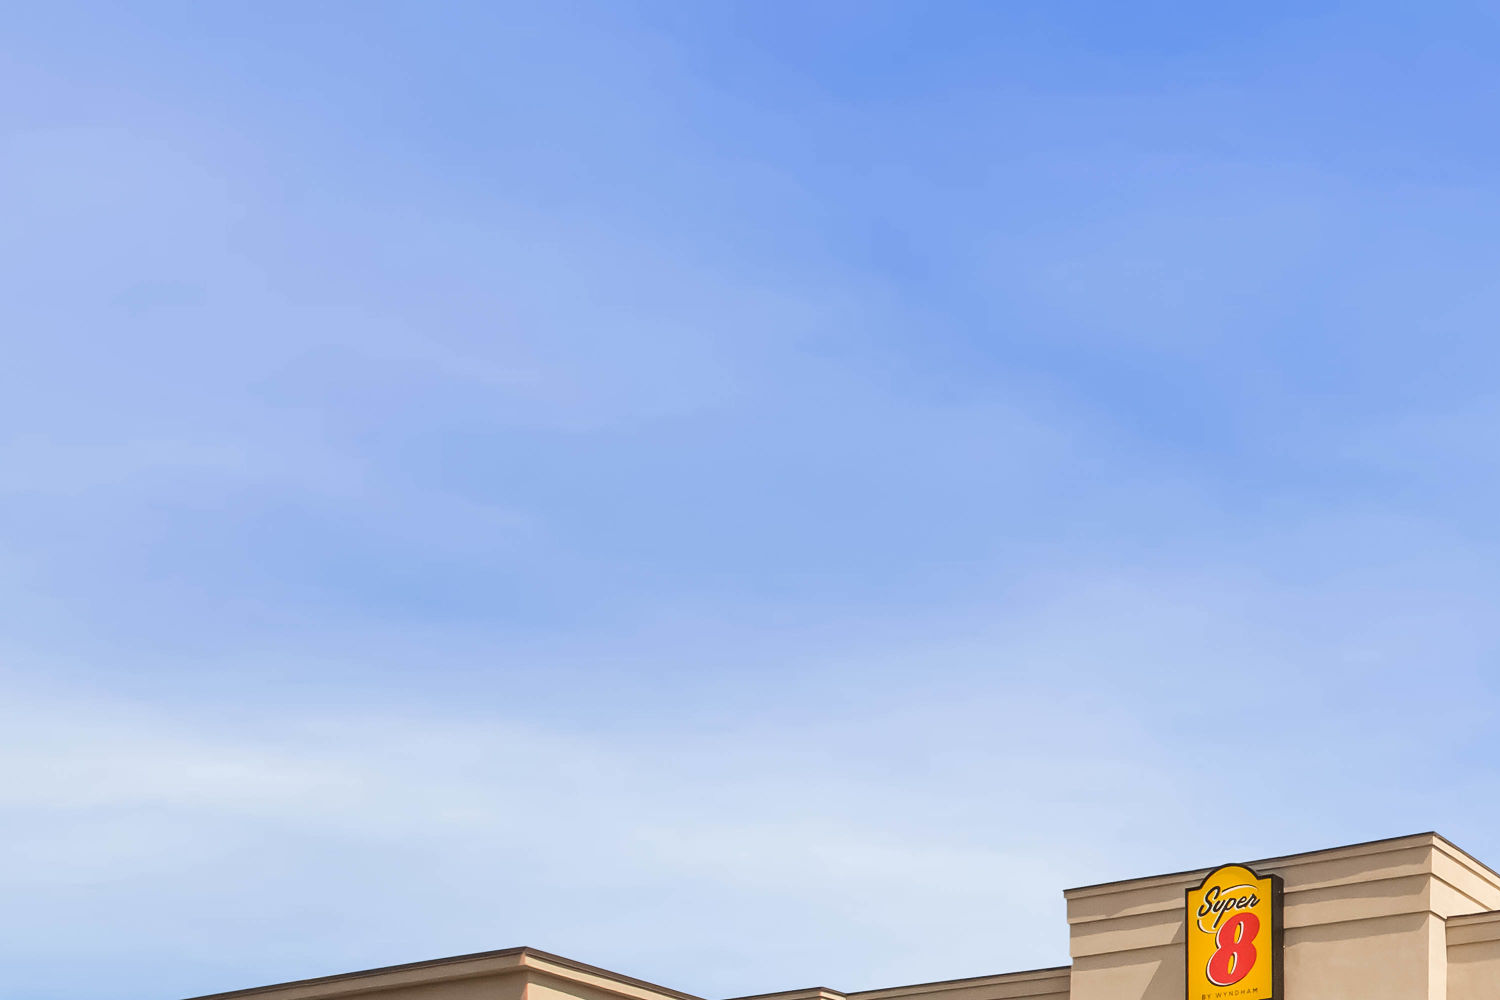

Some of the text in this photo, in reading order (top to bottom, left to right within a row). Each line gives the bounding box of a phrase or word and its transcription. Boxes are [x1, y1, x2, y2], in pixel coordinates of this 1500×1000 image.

[1197, 886, 1260, 929] Super
[1206, 912, 1260, 987] 8
[1201, 987, 1259, 1000] BY WYNDHAM
